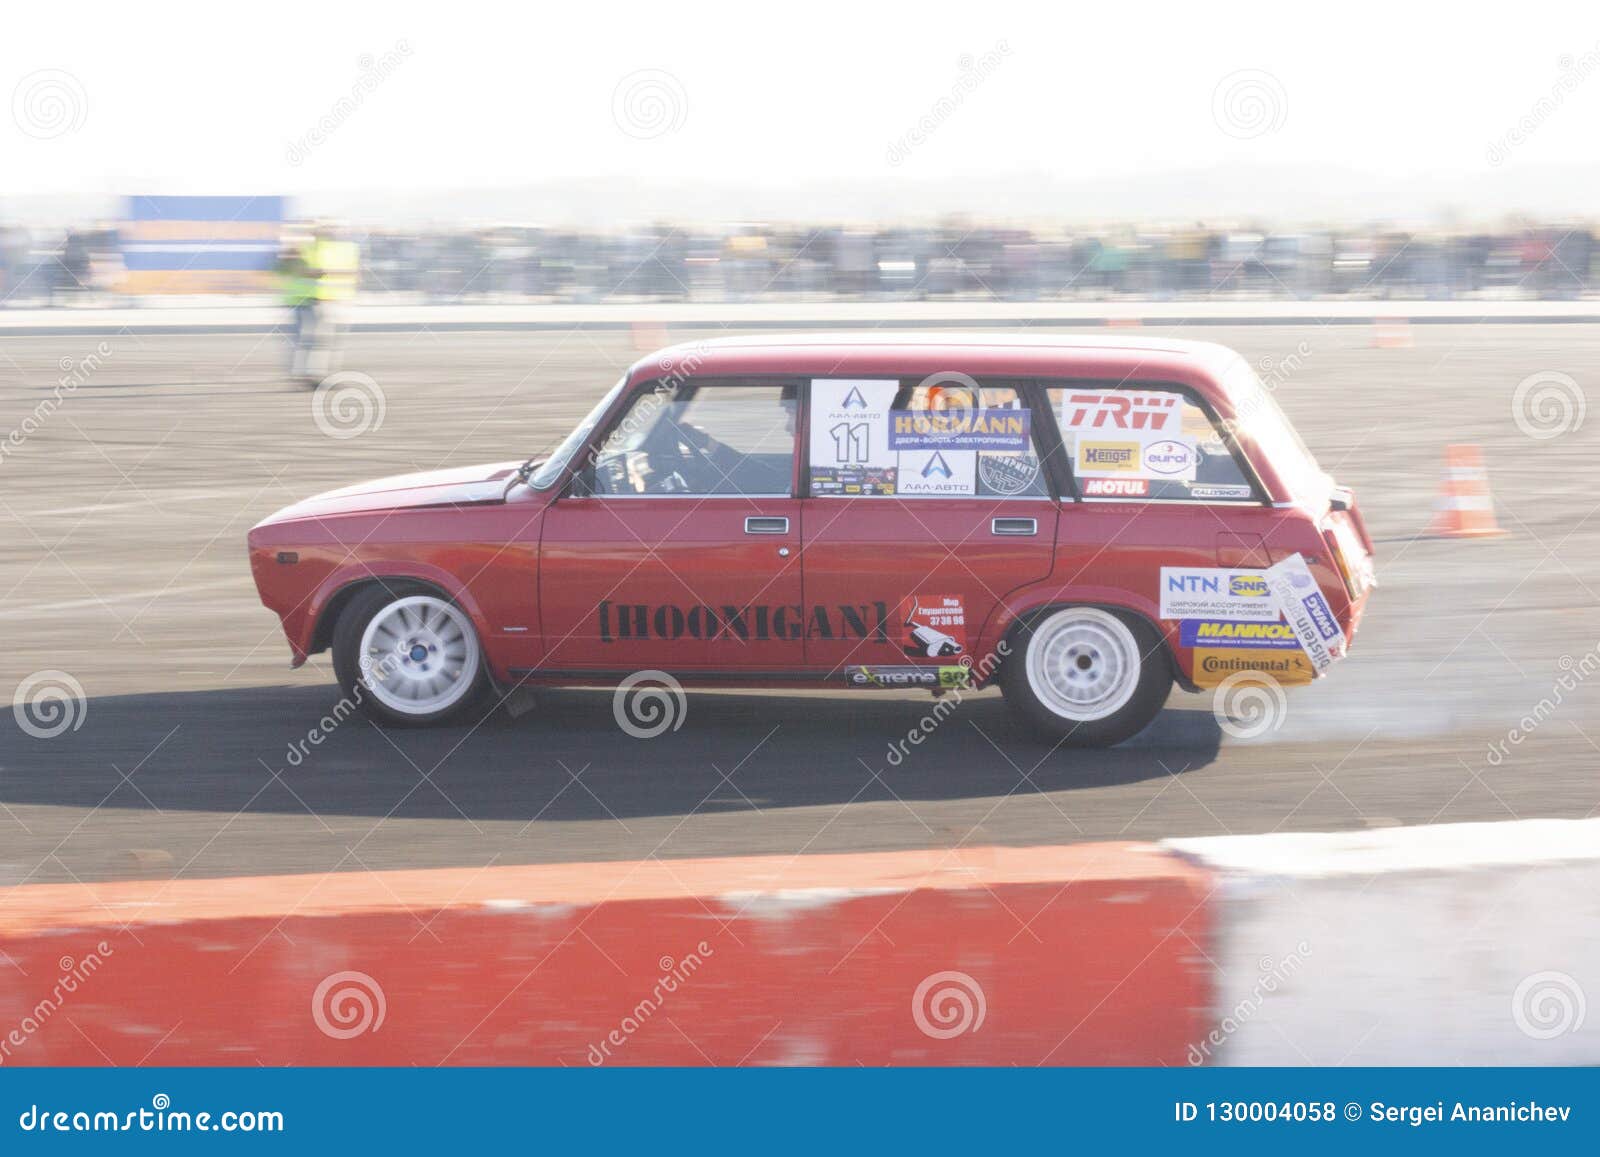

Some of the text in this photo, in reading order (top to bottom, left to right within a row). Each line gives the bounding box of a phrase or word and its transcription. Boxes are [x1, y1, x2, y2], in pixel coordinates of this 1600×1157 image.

[1070, 394, 1176, 430] TRW
[830, 422, 869, 463] 11
[1085, 448, 1132, 463] Hengst
[1148, 454, 1187, 463] eurol
[1086, 481, 1146, 495] MOTUL
[1169, 575, 1269, 593] NTN SNR
[1306, 596, 1335, 639] SWAG
[1197, 623, 1296, 639] MANNOL
[1202, 656, 1289, 673] Continental
